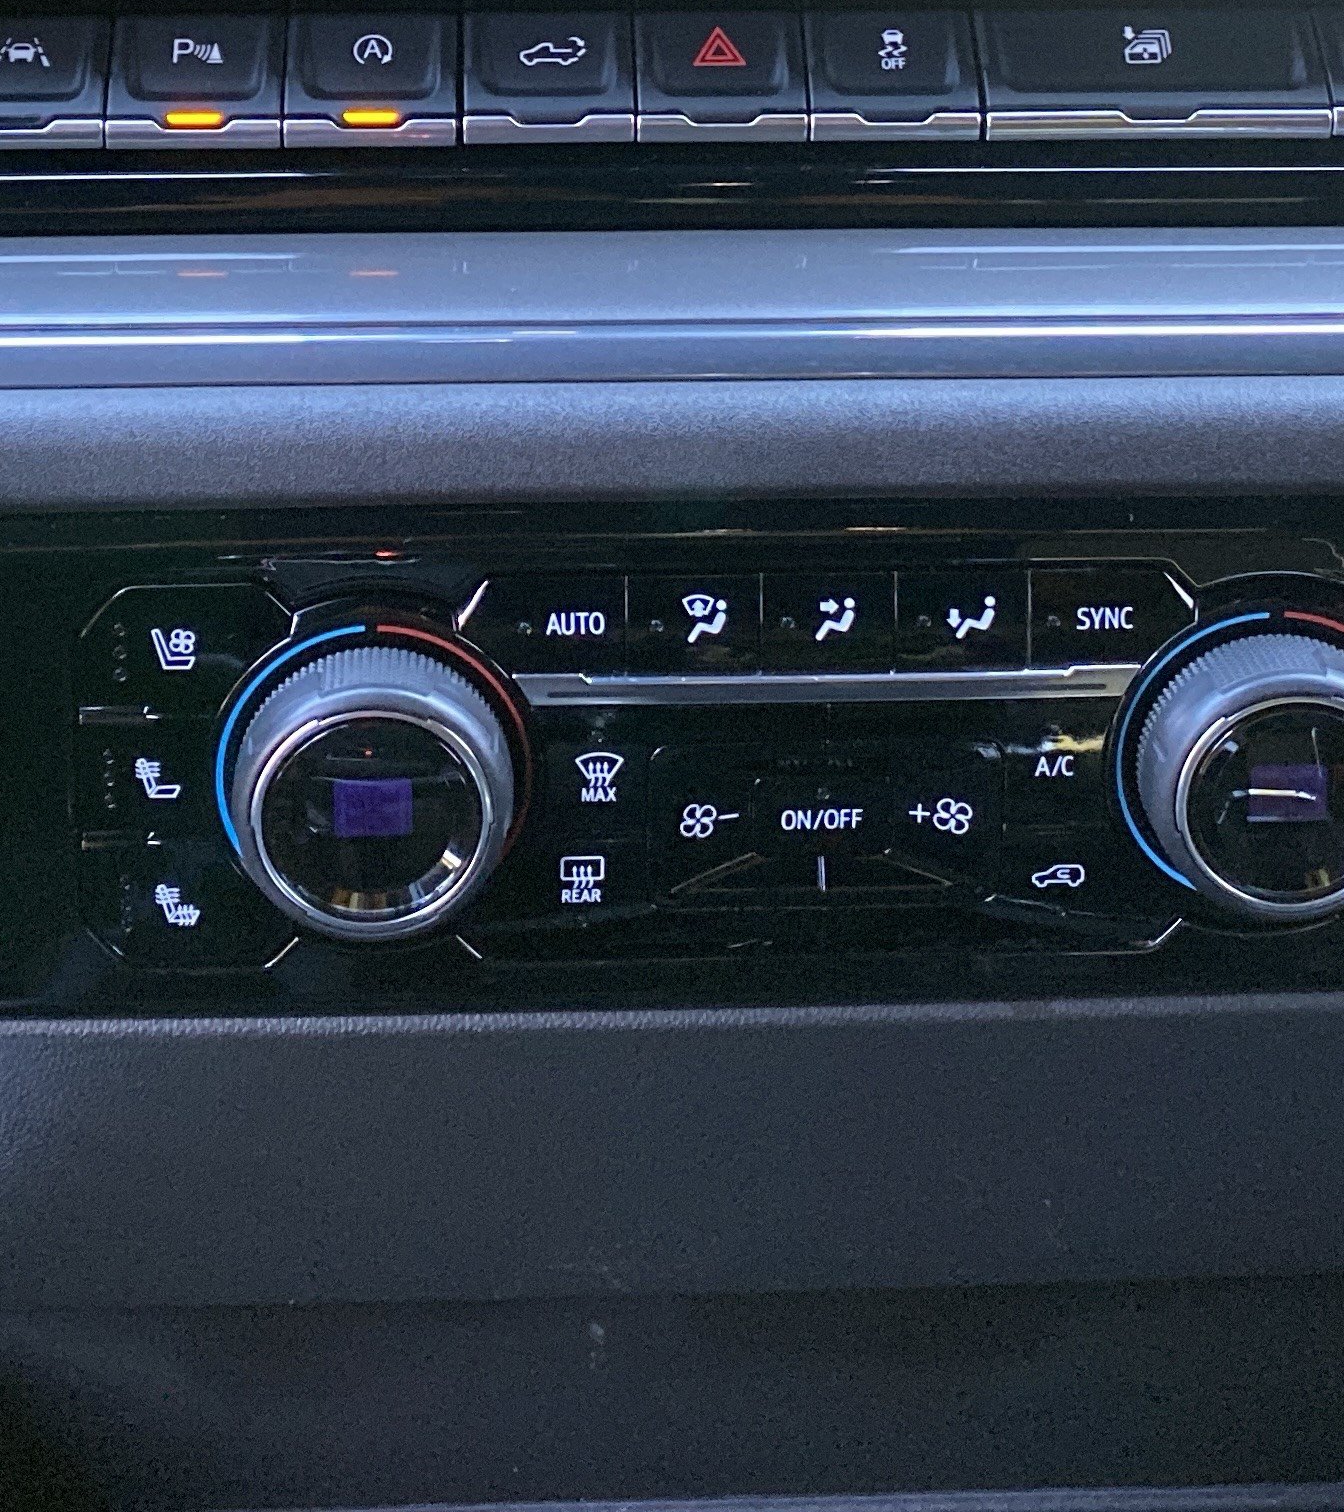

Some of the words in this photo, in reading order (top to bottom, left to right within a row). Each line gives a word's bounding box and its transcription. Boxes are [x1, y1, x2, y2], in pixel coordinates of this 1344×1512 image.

[881, 57, 906, 70] OFF
[546, 611, 605, 636] AUTO
[1076, 607, 1134, 631] SYNC
[1035, 756, 1074, 777] A/C
[581, 786, 617, 803] MAX
[781, 809, 863, 830] ON/OFF
[561, 889, 602, 903] REAR
